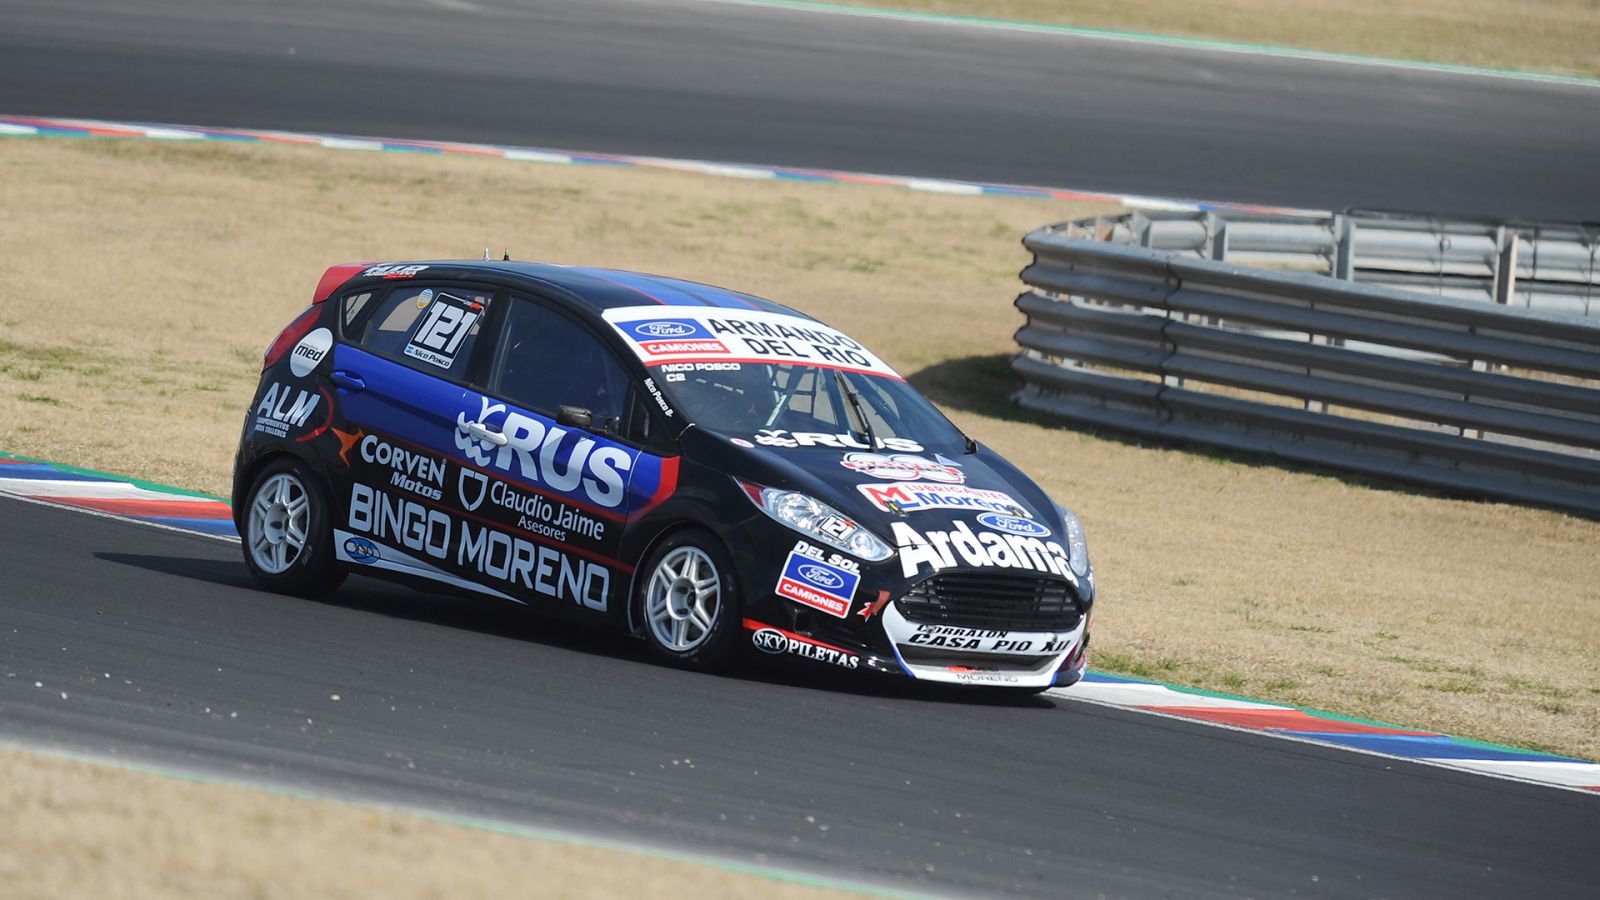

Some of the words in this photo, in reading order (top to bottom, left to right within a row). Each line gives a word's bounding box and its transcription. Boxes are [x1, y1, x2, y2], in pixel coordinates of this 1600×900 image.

[413, 301, 478, 354] 121
[648, 323, 686, 334] Ford
[707, 318, 862, 351] ARMANDO
[294, 345, 325, 362] med
[414, 349, 430, 360] Nico
[429, 354, 450, 367] Posco
[647, 343, 725, 353] CAMIONES
[742, 338, 811, 359] DEL
[812, 344, 872, 368] RIO
[661, 363, 694, 373] NICO
[695, 363, 741, 371] POSCO
[666, 373, 686, 382] C2
[257, 382, 320, 428] ALM
[644, 377, 657, 393] Nico
[653, 391, 669, 411] Posco
[791, 431, 925, 453] RUS
[360, 434, 447, 488] CORVEN
[495, 411, 632, 508] RUS
[390, 471, 443, 501] Motos
[904, 484, 1009, 500] LUBRICANTES
[490, 481, 553, 523] Claudio
[553, 503, 605, 542] Jaime
[995, 516, 1036, 533] Ford
[518, 515, 566, 542] Asesores
[820, 516, 852, 542] 121
[349, 482, 451, 559] BINGO
[457, 520, 610, 613] MORENO
[793, 540, 825, 561] DEL
[828, 554, 861, 573] SOL
[890, 520, 1079, 588] Ardama
[805, 567, 835, 586] Ford
[782, 583, 844, 611] CAMIONES
[908, 633, 981, 649] CASA
[991, 640, 1033, 652] PIO
[917, 624, 1009, 639] CORRALON
[755, 632, 784, 650] SKY
[788, 638, 860, 669] PILETAS
